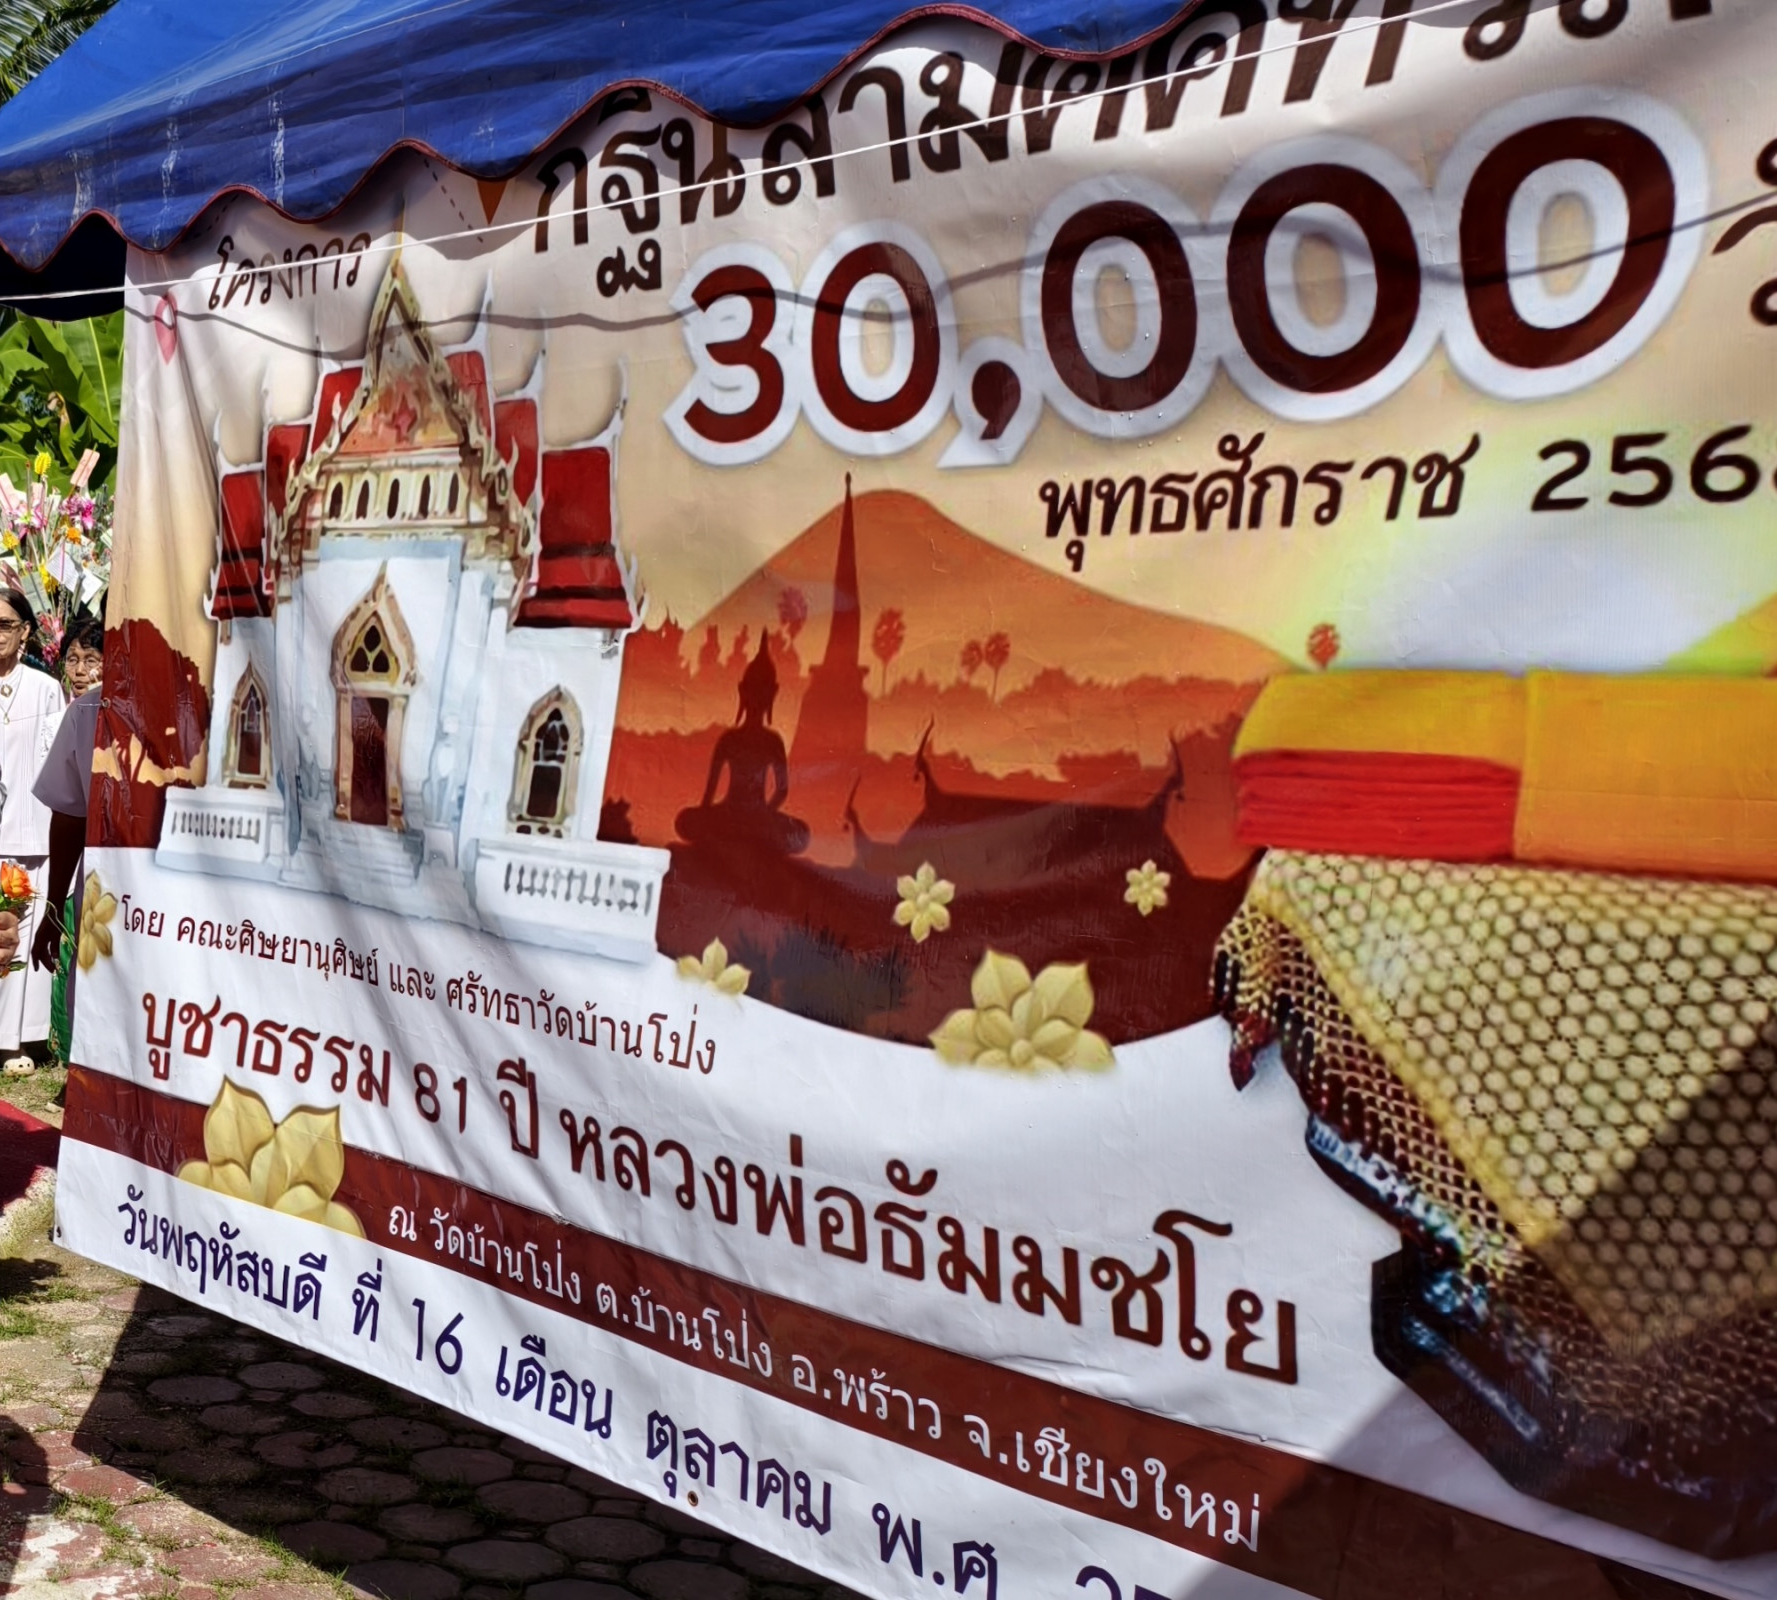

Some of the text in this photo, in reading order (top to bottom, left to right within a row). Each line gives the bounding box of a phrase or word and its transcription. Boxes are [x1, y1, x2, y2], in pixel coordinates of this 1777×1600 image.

[208, 231, 372, 311] โครงการ
[684, 115, 1677, 444] 30,000
[1038, 425, 1777, 572] พุทธศักราช 256
[121, 894, 717, 1075] โดย คณะศิษยานุศิษย์ และ ศรัทธาวัดบ้านโป่ง
[142, 991, 1300, 1386] บูชาธรรม 81 ปี หลวงพ่อธัมมชโย
[118, 1183, 328, 1321] วันพฤหัสบดี
[351, 1257, 383, 1342] ที่
[412, 1298, 464, 1375] 16
[495, 1333, 613, 1440] เดือน
[646, 1409, 832, 1536] ตุลาคม
[388, 1205, 1260, 1553] ณ วัดบ้านโป่ง ต.บ้านโป่ง อ.พร้าว จ.เชียงใหม่
